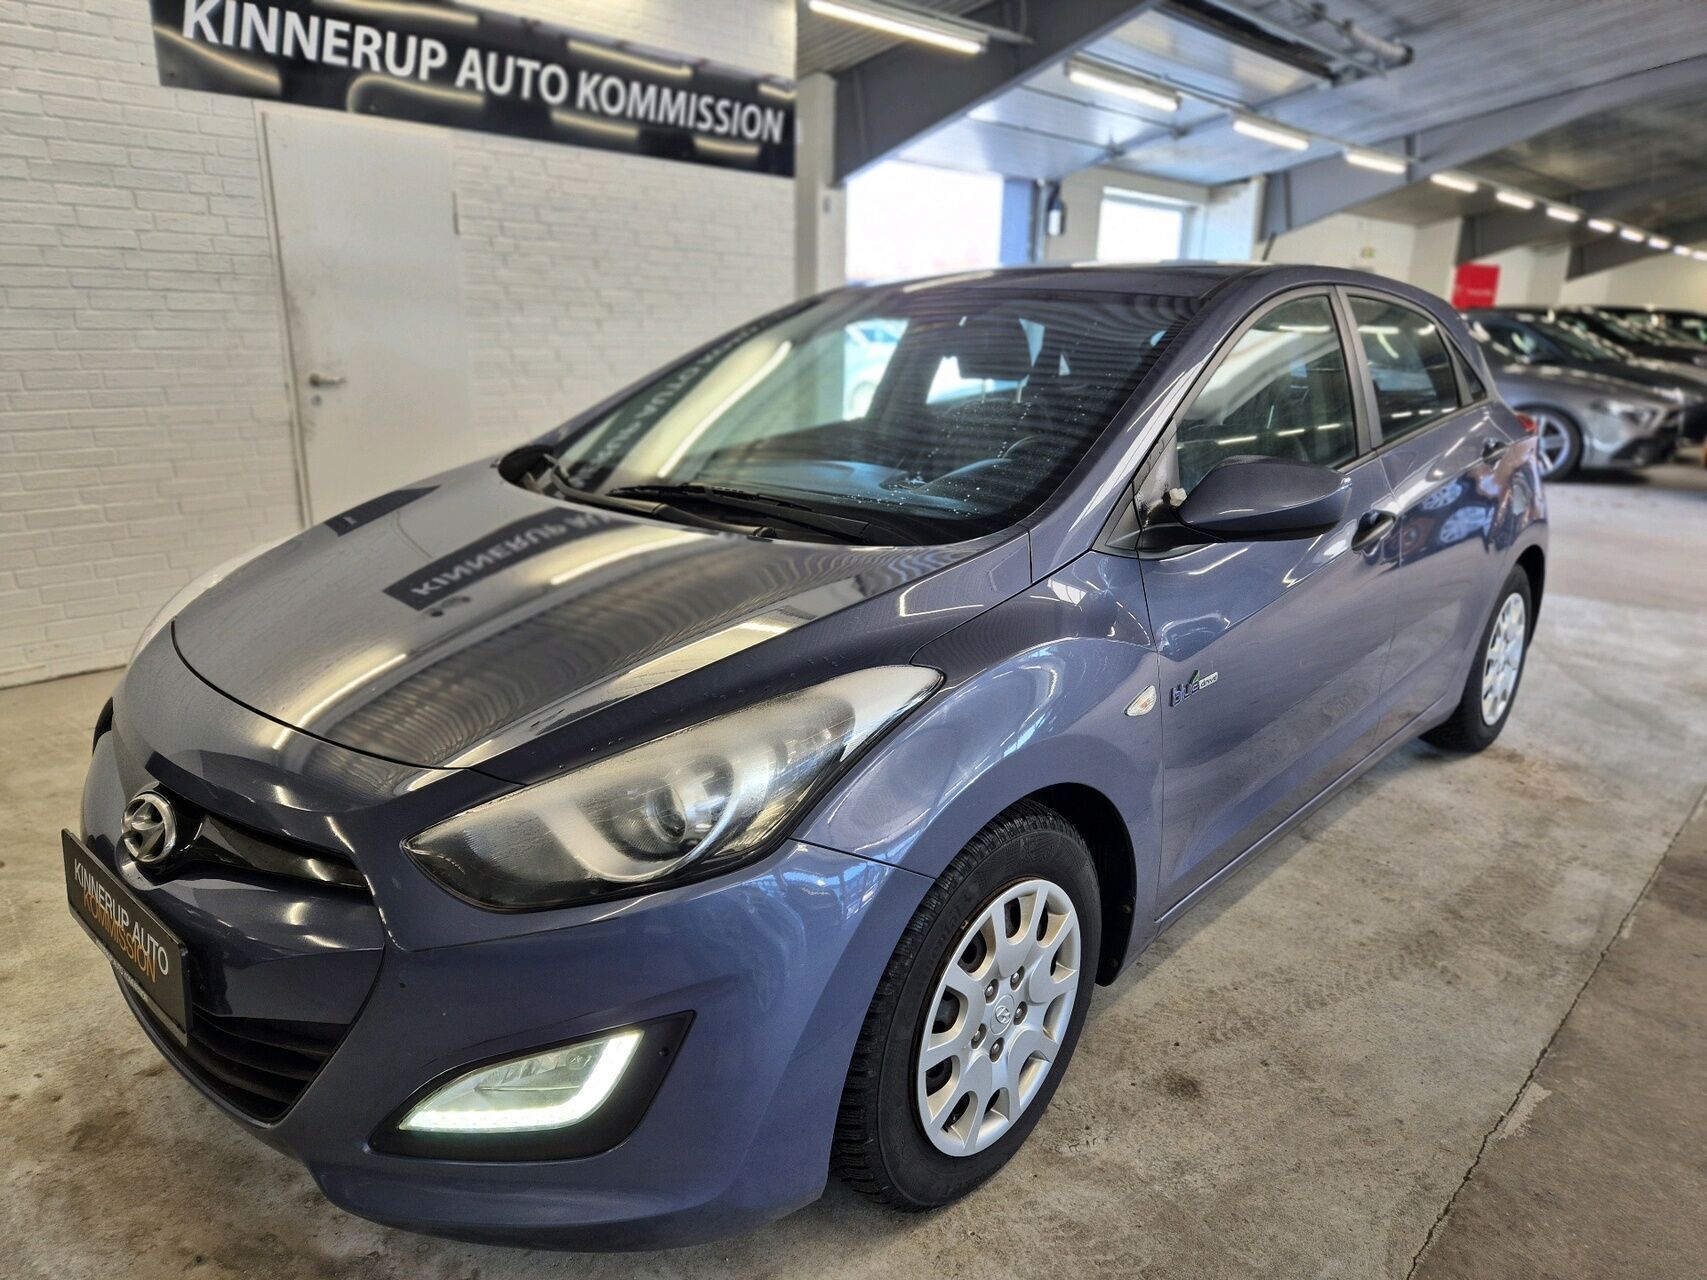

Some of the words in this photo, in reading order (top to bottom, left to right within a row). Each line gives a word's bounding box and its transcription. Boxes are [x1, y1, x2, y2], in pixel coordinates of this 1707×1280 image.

[182, 0, 448, 81] KINNERUP
[455, 48, 568, 104] AUTO
[576, 71, 785, 144] KOMMISSION
[74, 858, 129, 929] KINNERUP
[132, 921, 169, 976] AUTO
[83, 889, 157, 984] KOMMISSION
